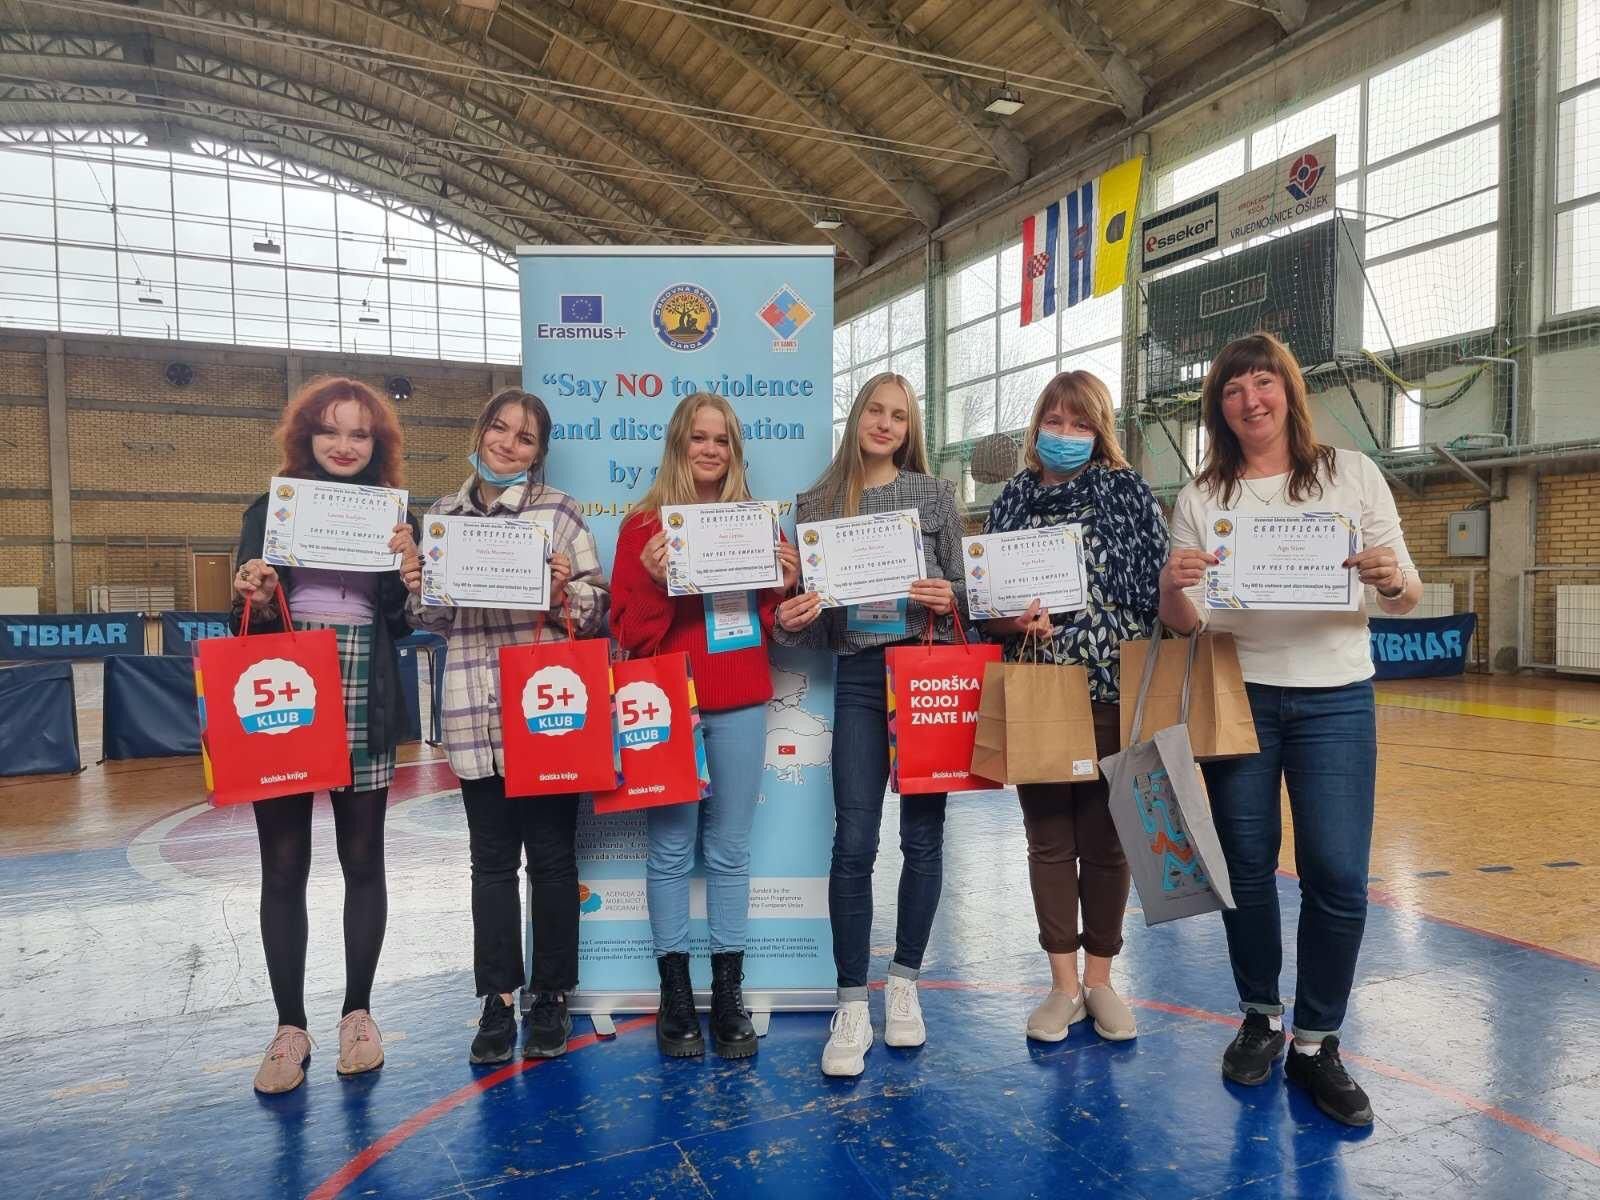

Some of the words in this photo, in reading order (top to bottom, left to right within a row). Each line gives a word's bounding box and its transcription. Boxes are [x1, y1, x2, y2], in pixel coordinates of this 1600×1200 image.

[1230, 209, 1293, 240] VRIJEDNOSNICE
[1295, 195, 1328, 216] OSIJEK
[1145, 218, 1214, 252] esseker
[537, 323, 627, 341] Erasmus+
[670, 340, 704, 350] DARDA
[615, 373, 663, 397] NO
[671, 374, 697, 397] to
[705, 373, 814, 397] violence
[552, 417, 601, 441] and
[608, 460, 642, 489] by
[313, 493, 387, 507] CERTIFICATE
[700, 514, 762, 523] CERTIFICATE
[462, 530, 532, 540] CERTIFICATE
[835, 524, 901, 538] CERTIFICATE
[7, 622, 128, 647] TIBHAR
[178, 621, 232, 642] TIB
[910, 675, 980, 691] PODRŠKA
[253, 678, 300, 707] 5+
[536, 684, 575, 710] 5+
[911, 695, 959, 708] KOJOJ
[256, 711, 299, 728] KLUB
[622, 700, 660, 726] 5+
[912, 712, 957, 725] ZNATE
[962, 712, 979, 724] IM
[538, 717, 573, 728] KLUB
[625, 730, 659, 744] KLUB
[260, 773, 286, 785] školska
[287, 771, 308, 782] knjiga
[539, 773, 560, 781] školska
[561, 772, 578, 781] knjiga
[628, 786, 648, 795] školska
[649, 784, 666, 793] knjiga
